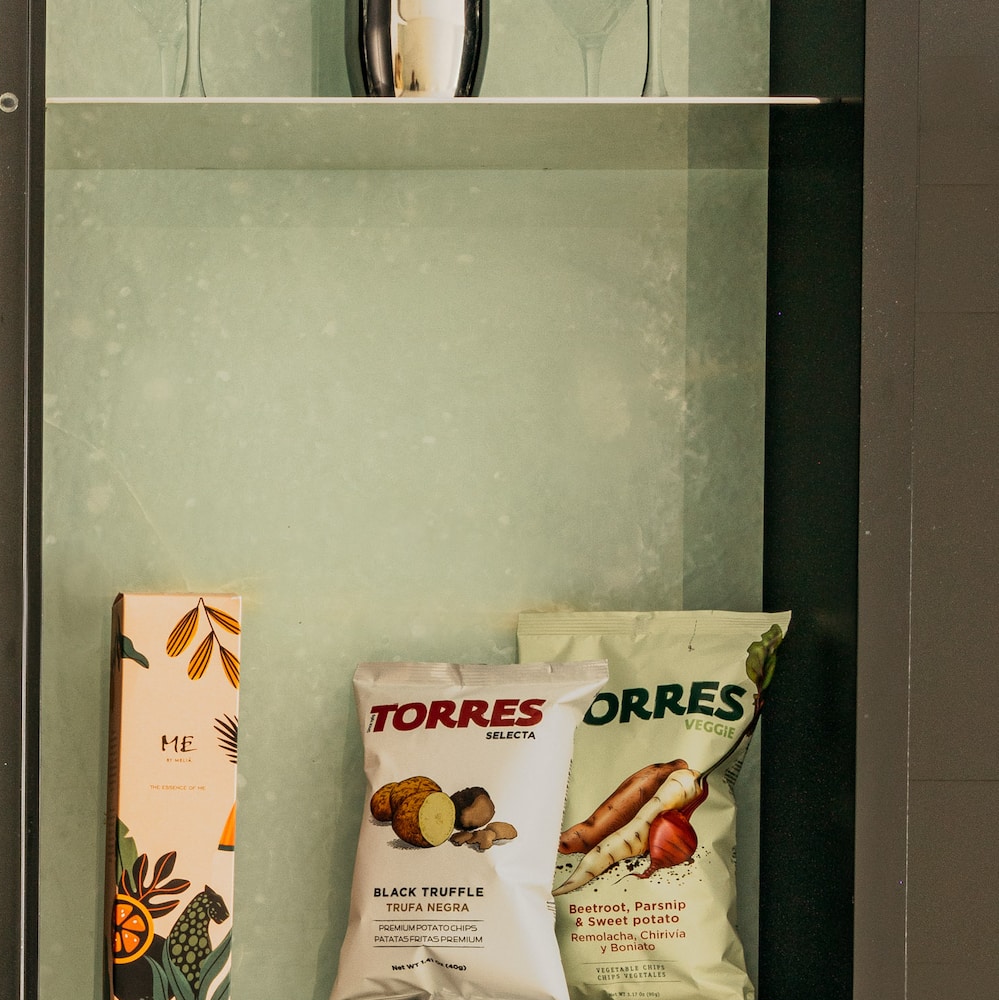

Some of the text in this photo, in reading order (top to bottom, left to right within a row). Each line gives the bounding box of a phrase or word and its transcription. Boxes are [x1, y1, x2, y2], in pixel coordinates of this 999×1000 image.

[582, 681, 747, 726] ORRES
[370, 698, 546, 732] TORRES
[485, 731, 536, 740] SELECTA
[162, 734, 198, 752] ME
[374, 887, 484, 897] BLACK TRUFFLE
[386, 903, 469, 912] TRUFA NEGRA
[569, 900, 686, 914] Beetroot, Parsnip
[576, 914, 680, 927] & Sweet potato
[571, 929, 686, 942] Remolacha, Chirivía
[601, 943, 656, 954] y Boniato
